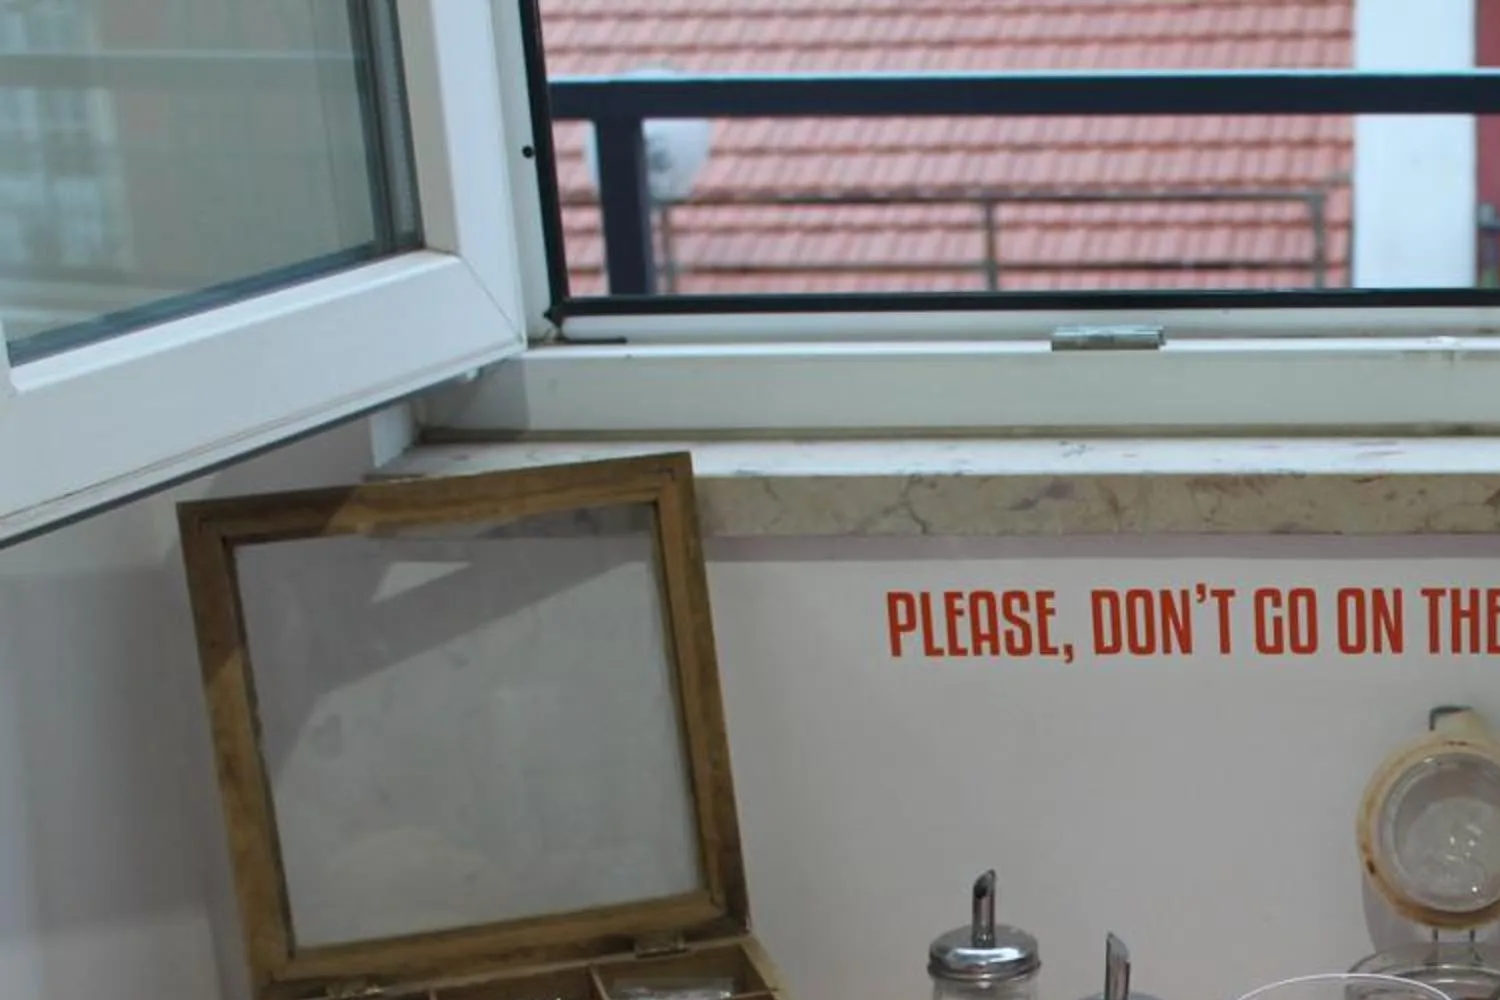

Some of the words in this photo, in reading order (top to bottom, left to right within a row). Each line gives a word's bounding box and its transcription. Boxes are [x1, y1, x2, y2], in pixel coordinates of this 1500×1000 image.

[887, 589, 1073, 664] PLEASE,
[1090, 583, 1235, 657] DON'T
[1253, 587, 1318, 656] GO
[1337, 587, 1404, 656] ON
